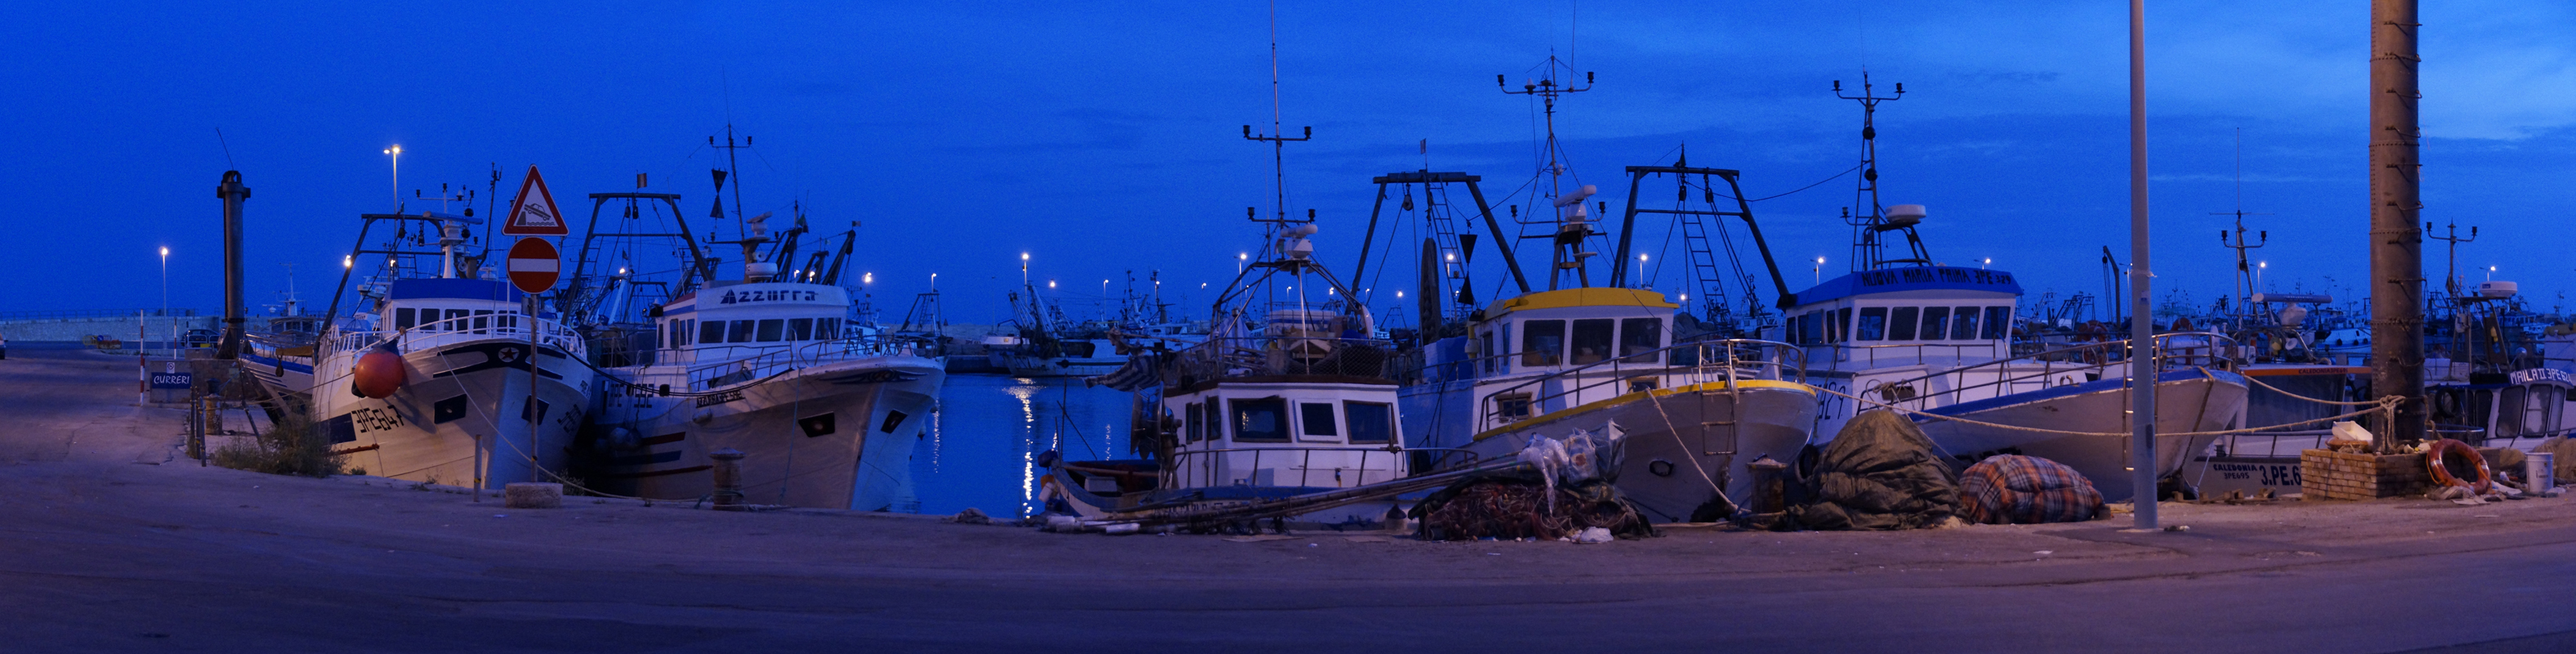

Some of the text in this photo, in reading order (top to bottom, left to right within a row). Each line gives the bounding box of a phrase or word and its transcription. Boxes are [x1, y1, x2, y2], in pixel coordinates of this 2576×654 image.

[1902, 269, 1935, 284] MARIA
[1938, 268, 1971, 284] PRIMA
[154, 375, 190, 384] CURRERI
[2509, 368, 2539, 384] MAILA
